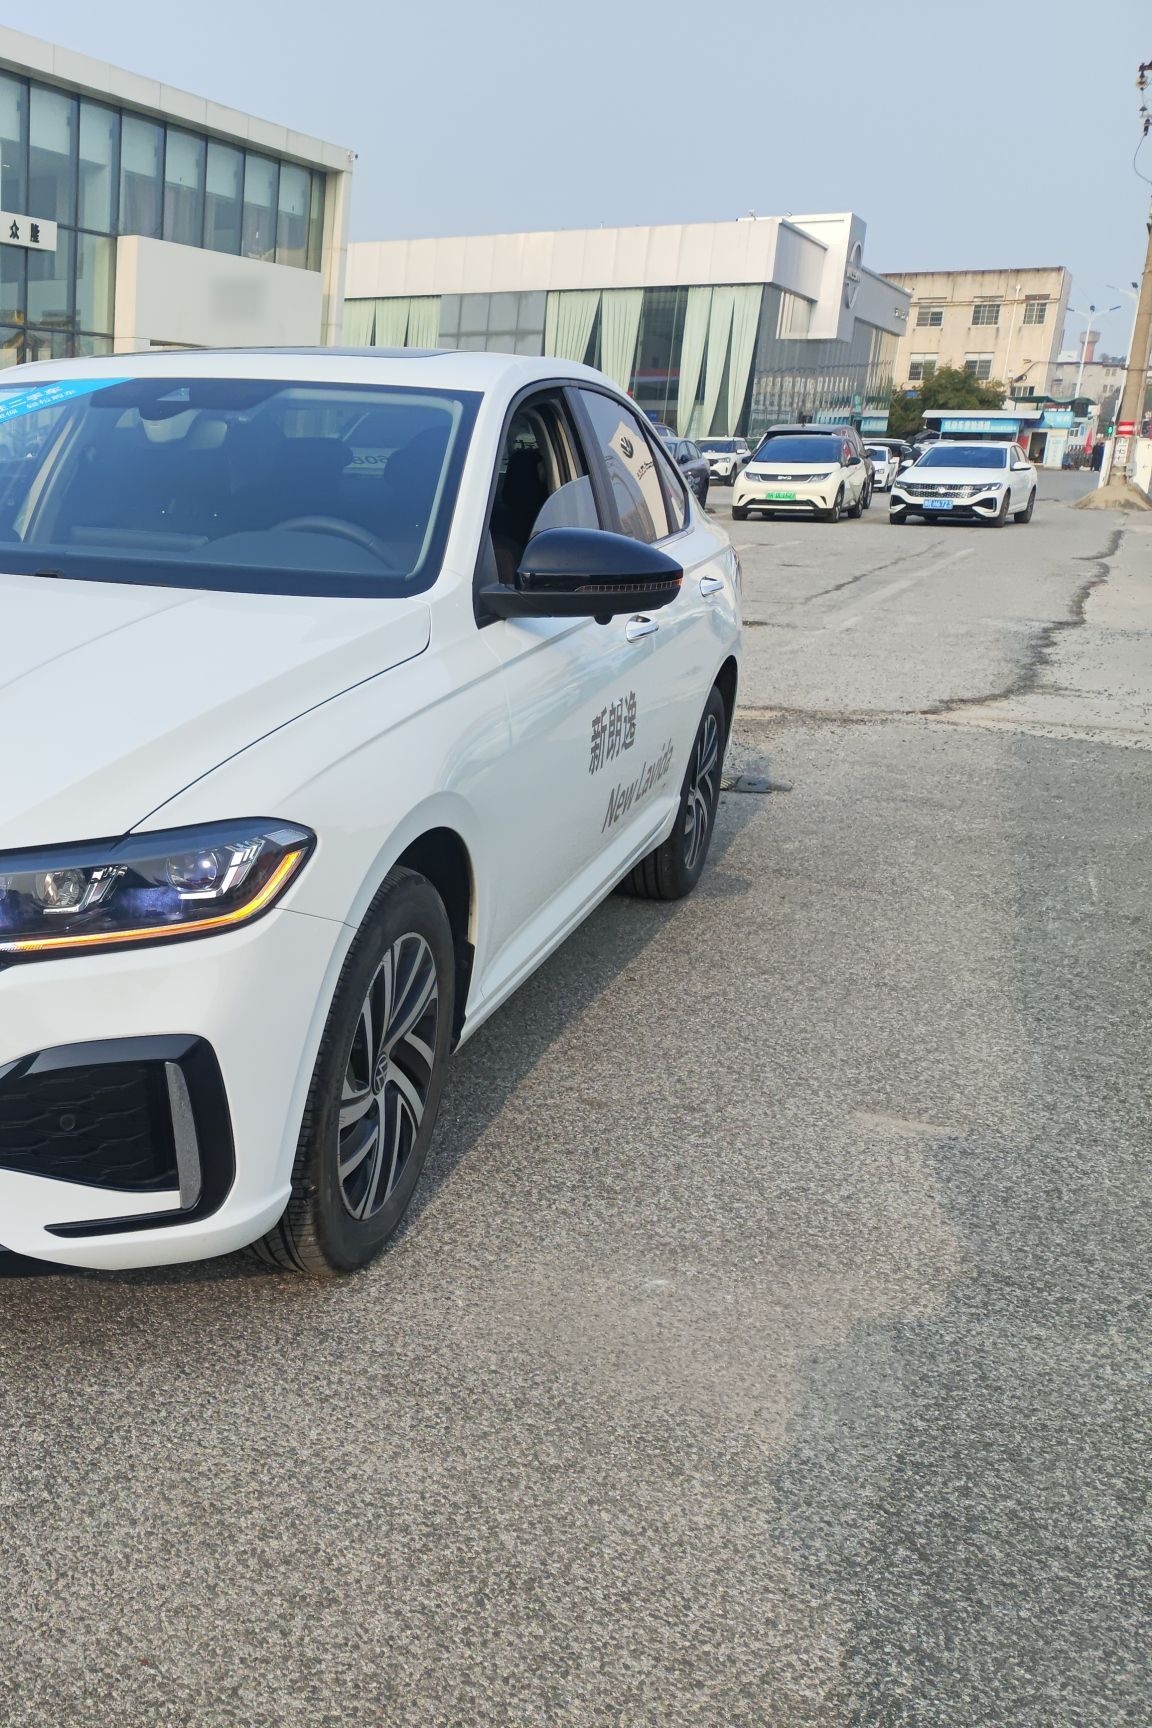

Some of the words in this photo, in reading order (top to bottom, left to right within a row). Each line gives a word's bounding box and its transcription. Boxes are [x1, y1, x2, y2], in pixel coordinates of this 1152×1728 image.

[589, 690, 637, 775] 新朗逸
[601, 779, 639, 834] New
[635, 738, 674, 802] Lavida
